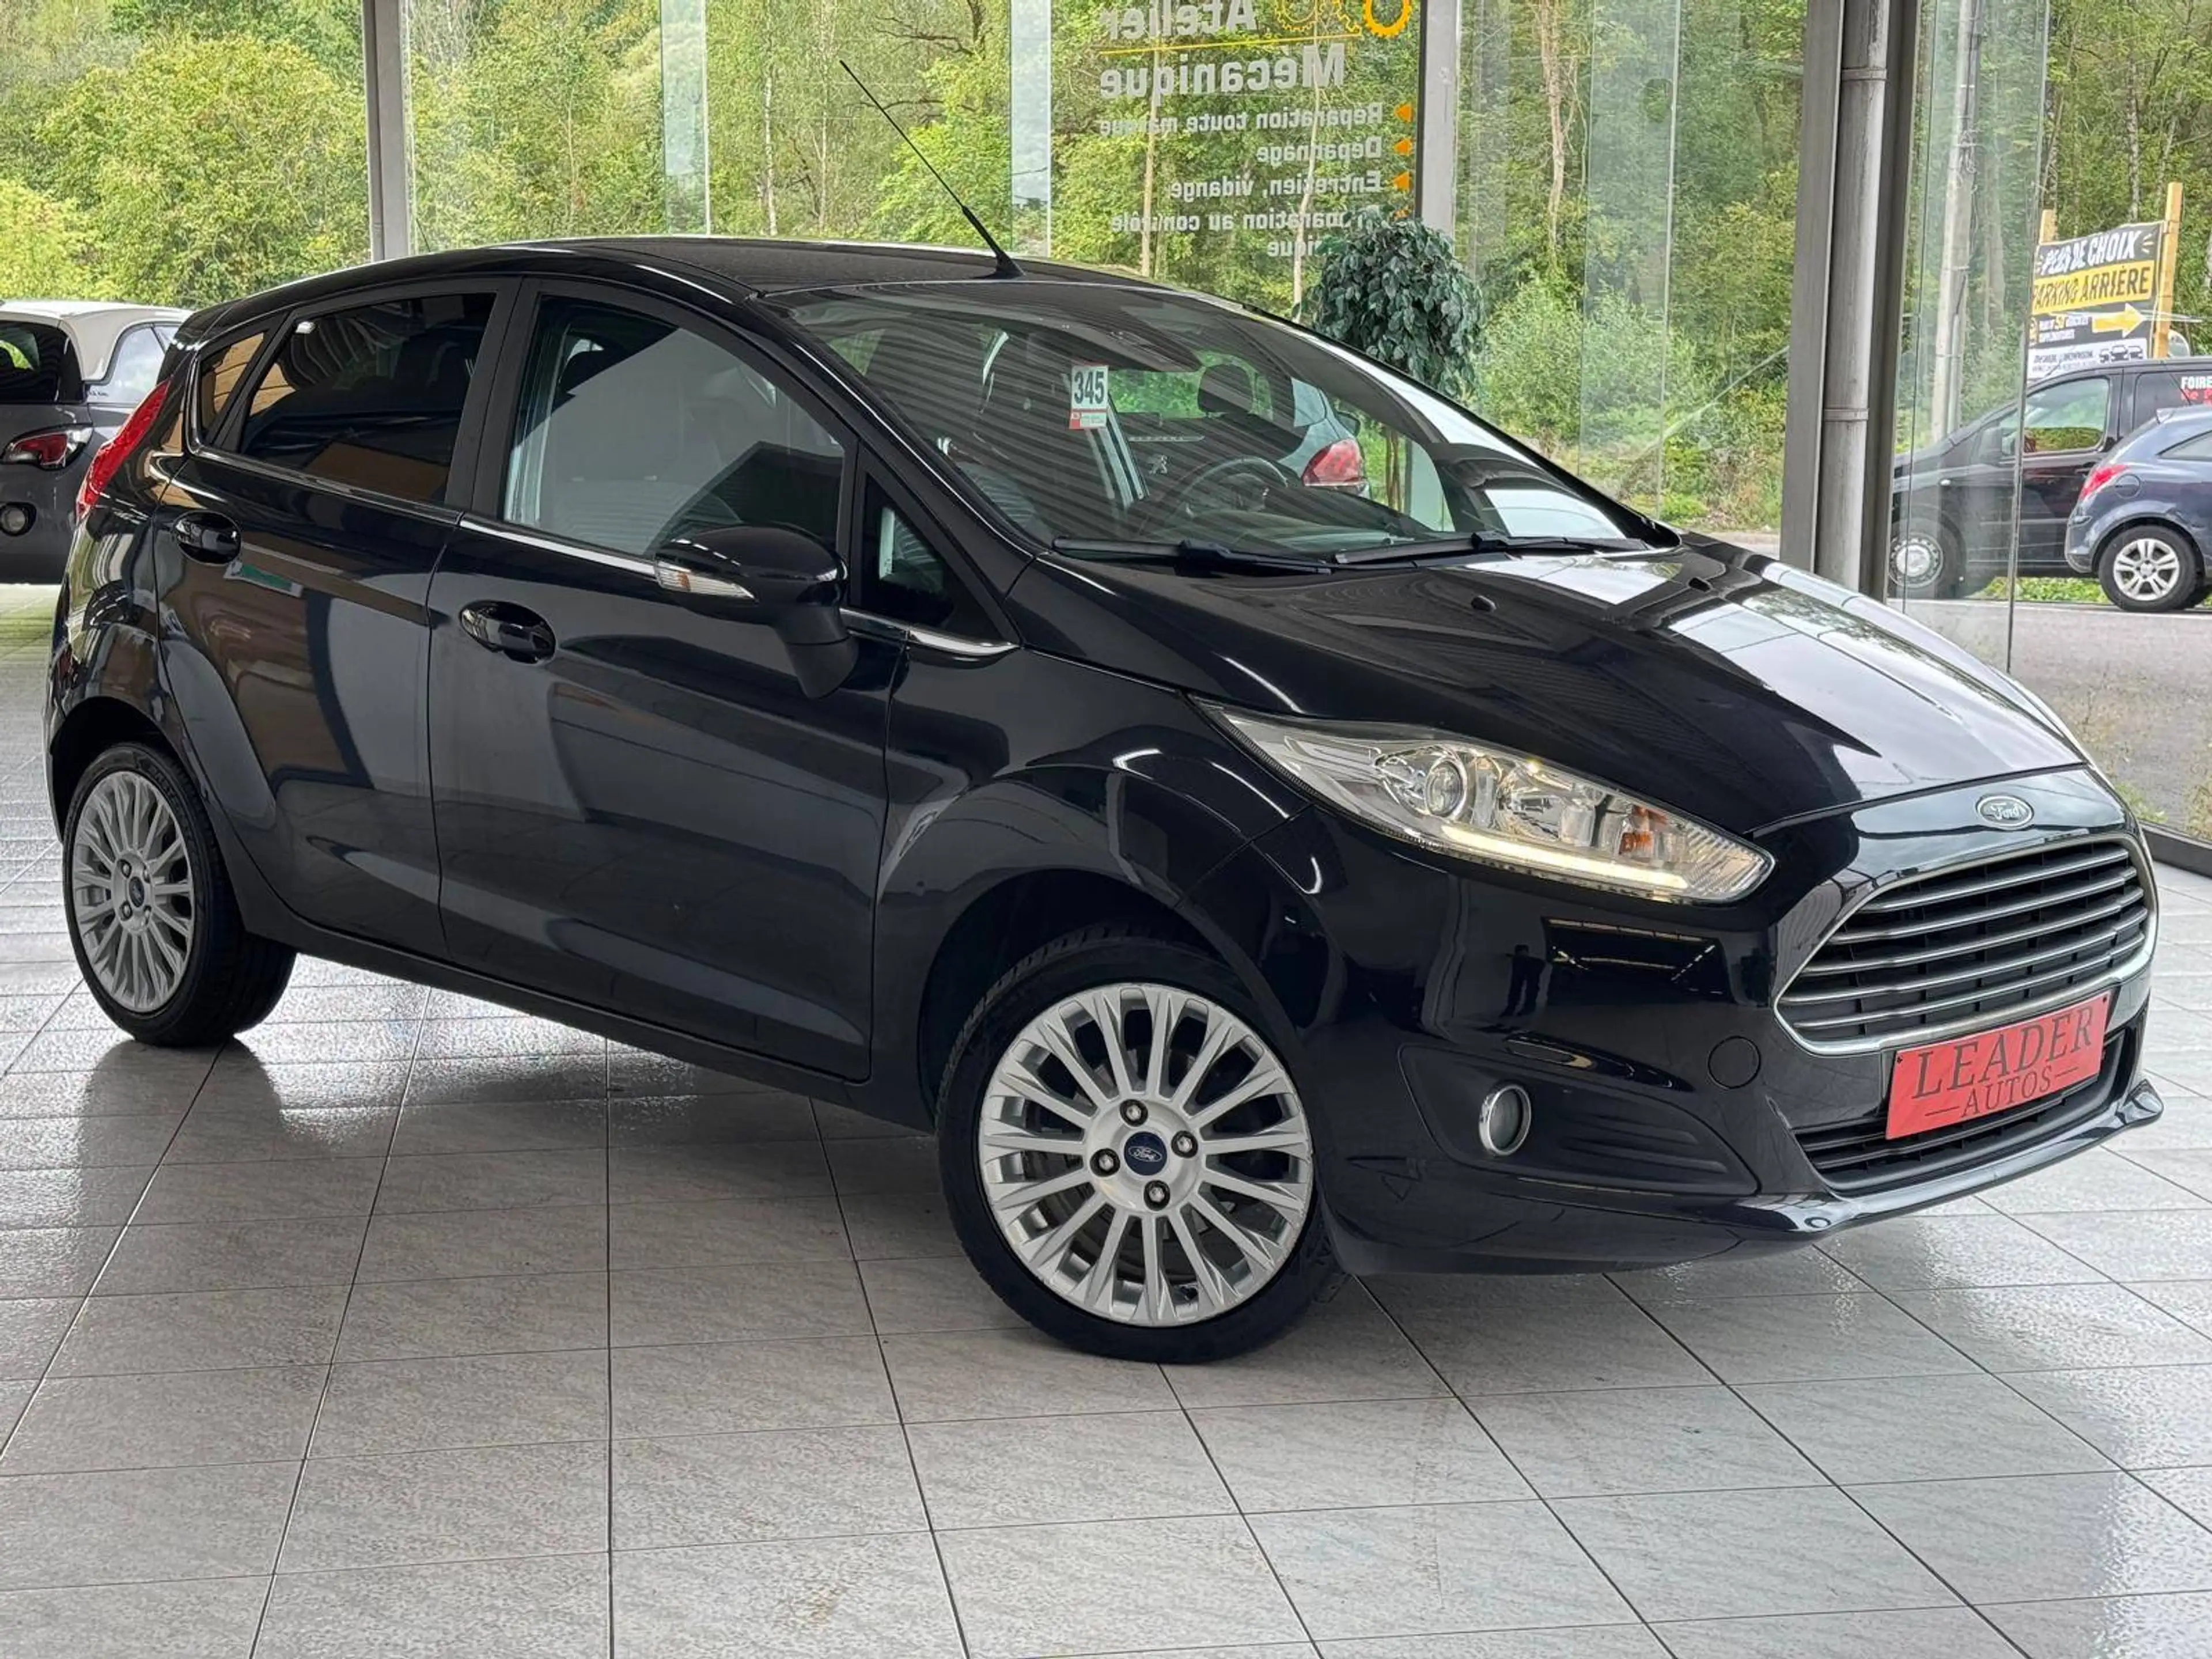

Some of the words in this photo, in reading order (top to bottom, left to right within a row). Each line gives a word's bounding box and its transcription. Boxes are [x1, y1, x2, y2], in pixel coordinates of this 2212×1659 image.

[2070, 240, 2088, 271] DE
[2087, 230, 2142, 266] CHOIX
[1074, 370, 1105, 405] 345
[1911, 1005, 2092, 1099] LEADER
[1961, 1065, 2052, 1118] AUTOS
